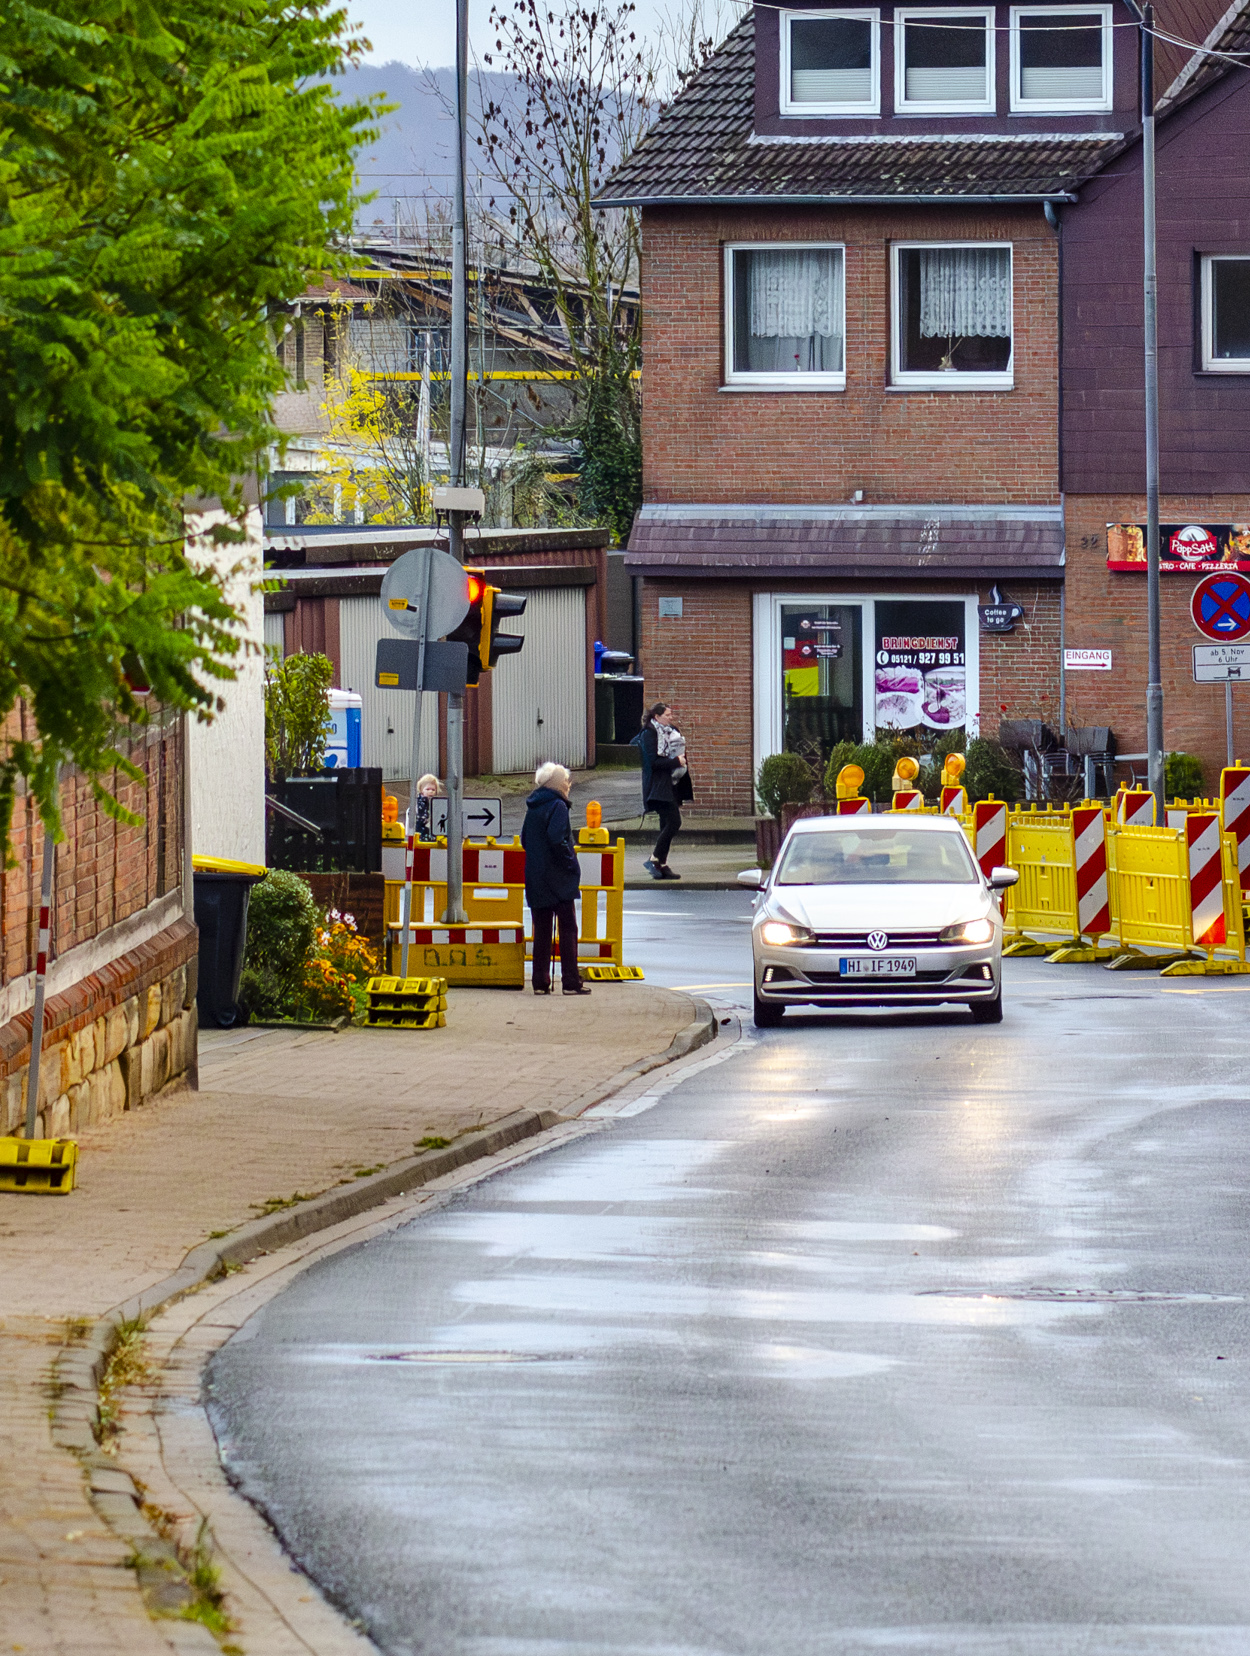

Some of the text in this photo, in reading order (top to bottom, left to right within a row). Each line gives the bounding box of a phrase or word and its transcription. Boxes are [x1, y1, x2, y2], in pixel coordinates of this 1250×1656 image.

[1171, 541, 1216, 558] PappSatt
[1201, 562, 1239, 570] PIZZERIA
[984, 608, 1007, 616] Coffee
[995, 617, 1005, 625] go
[882, 636, 959, 650] BRINGDIENST
[891, 654, 912, 664] 05121
[918, 652, 936, 664] 927
[938, 652, 951, 664] 99
[953, 652, 965, 664] 51
[1066, 650, 1110, 660] EINGANG
[848, 959, 915, 973] HI IF 1949
